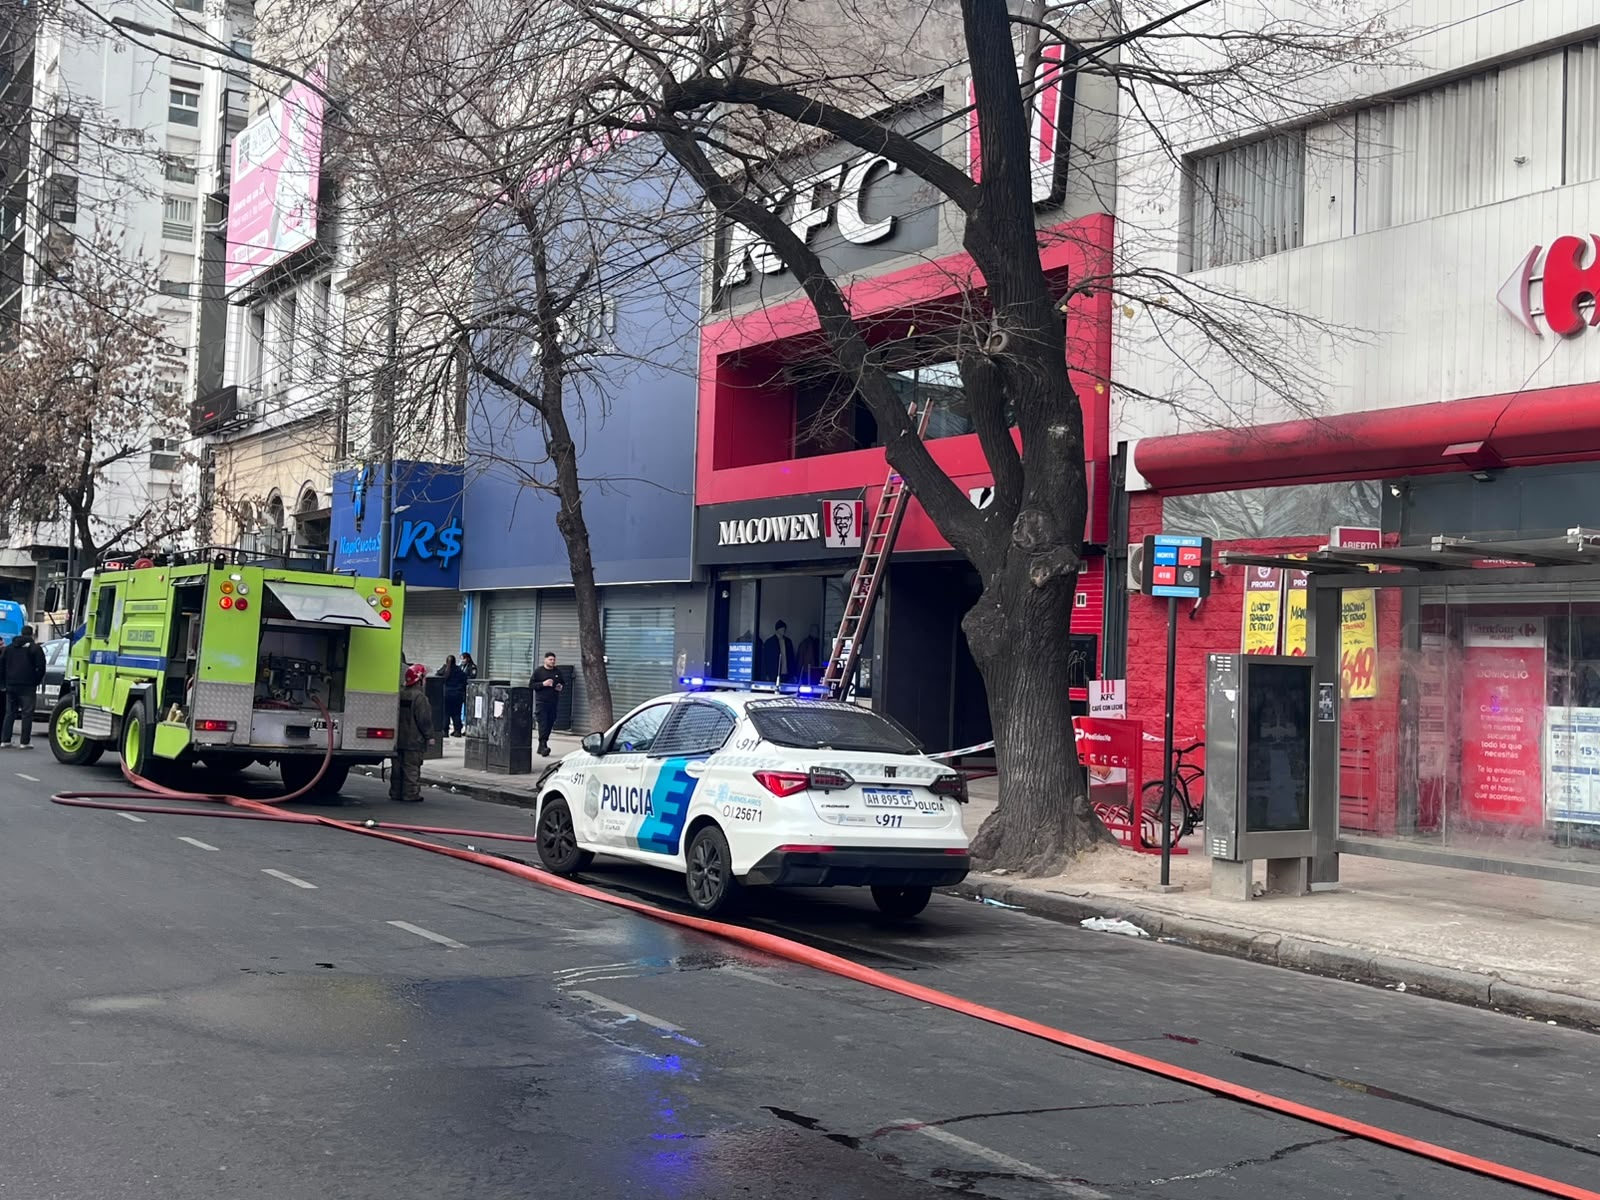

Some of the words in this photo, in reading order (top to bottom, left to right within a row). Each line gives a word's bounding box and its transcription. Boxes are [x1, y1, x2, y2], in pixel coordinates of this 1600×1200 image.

[718, 513, 820, 546] MACOWEN
[397, 518, 463, 568] R$
[1342, 541, 1378, 549] ABIERTO
[1477, 670, 1529, 679] DOMICILIO
[1100, 693, 1115, 701] KFC
[573, 773, 585, 785] 911
[601, 784, 654, 816] POLICIA
[867, 795, 879, 805] AH
[881, 795, 899, 806] 895
[901, 796, 912, 806] CF
[882, 813, 903, 828] 911
